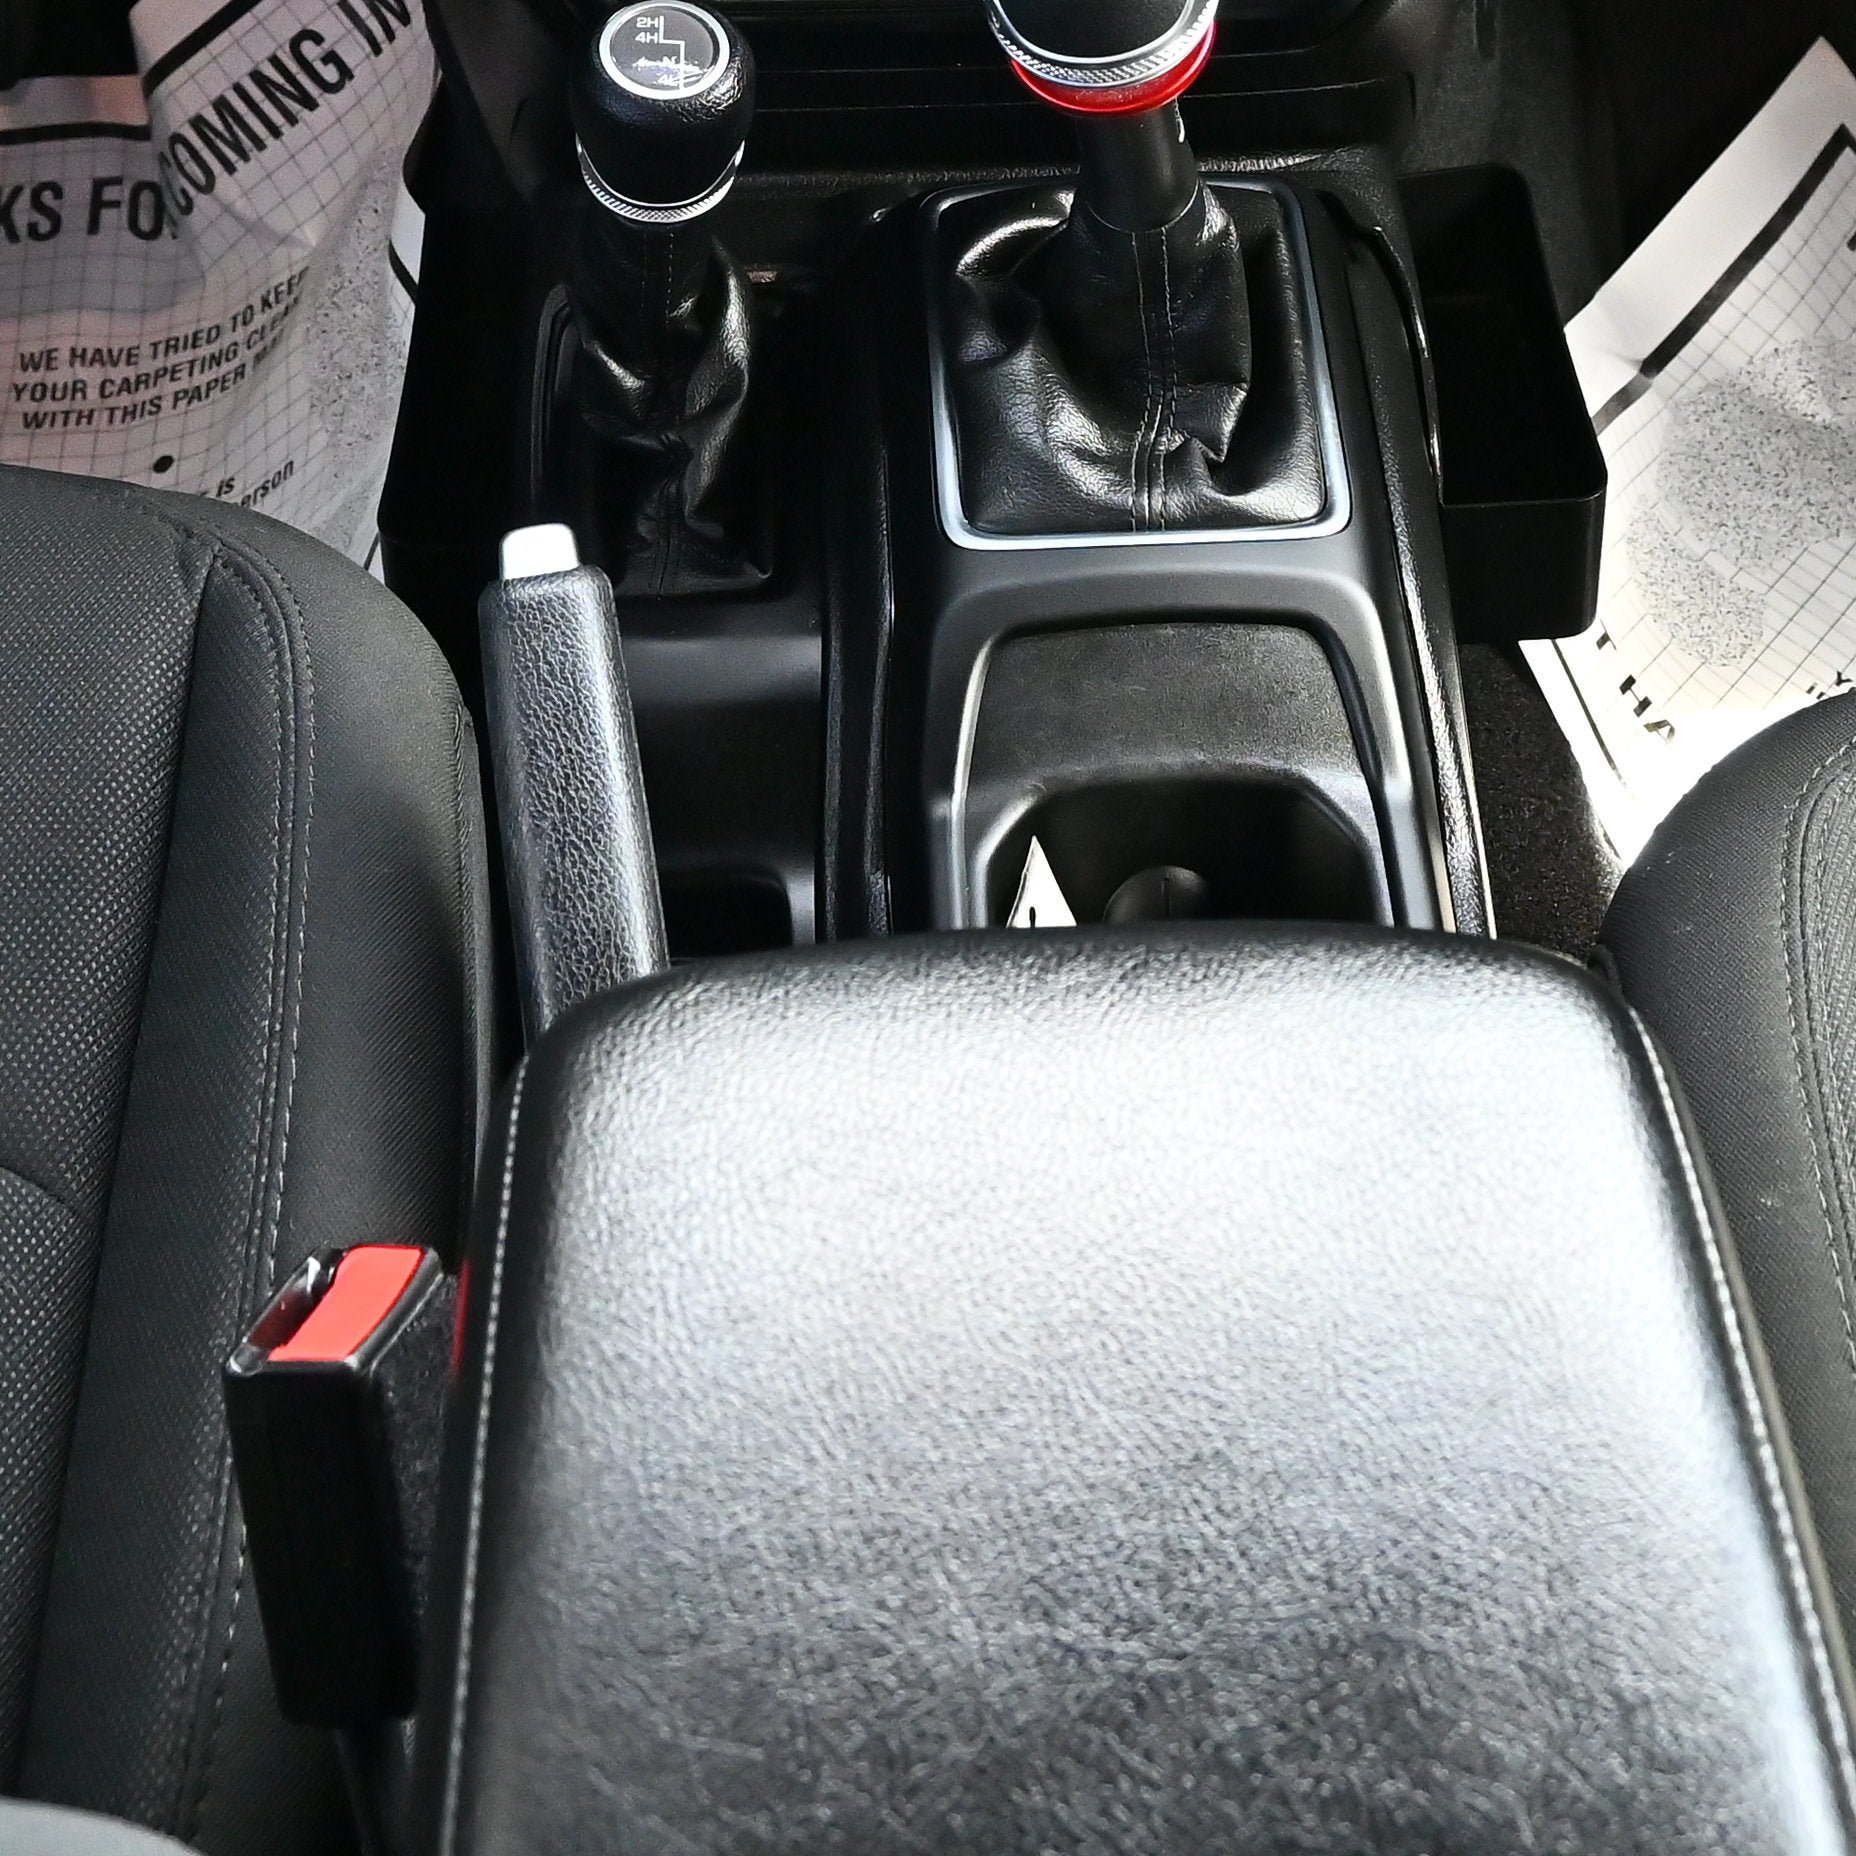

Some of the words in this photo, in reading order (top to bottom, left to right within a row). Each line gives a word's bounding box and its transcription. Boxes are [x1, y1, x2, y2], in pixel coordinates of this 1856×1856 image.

[635, 32, 658, 44] 4H
[636, 16, 658, 28] 2H
[159, 29, 355, 215] COMING
[20, 348, 60, 373] WE
[69, 345, 140, 369] HAVE
[149, 324, 221, 361] TRIED
[229, 304, 255, 334] TO
[12, 378, 87, 404] YOUR
[99, 342, 238, 400] CARPETING
[22, 408, 94, 430] WITH
[105, 396, 162, 424] THIS
[172, 363, 246, 410] PAPER
[215, 476, 235, 498] is
